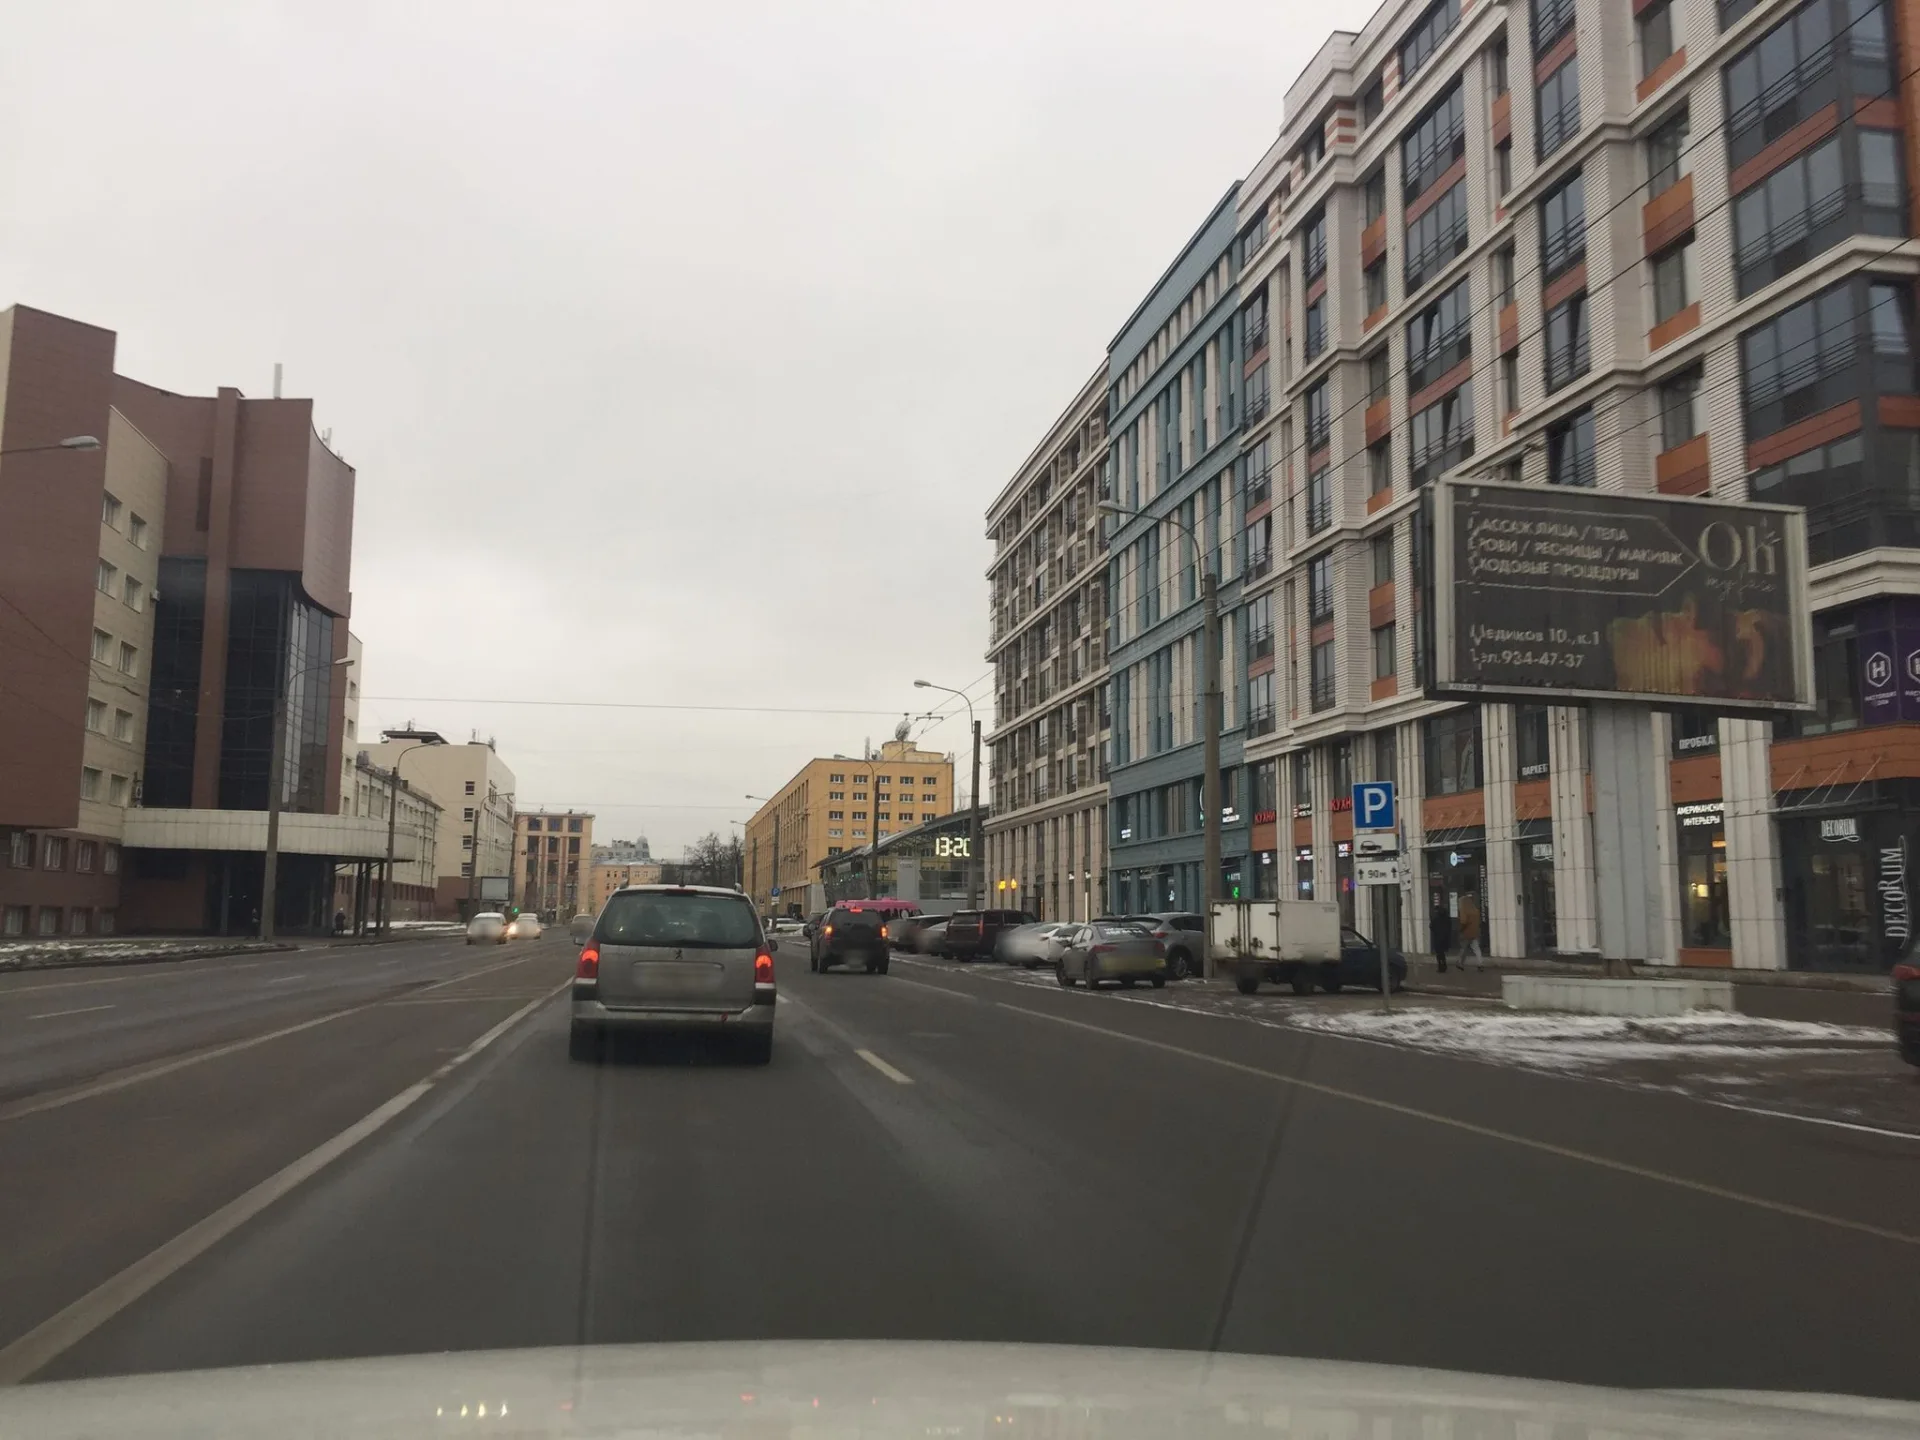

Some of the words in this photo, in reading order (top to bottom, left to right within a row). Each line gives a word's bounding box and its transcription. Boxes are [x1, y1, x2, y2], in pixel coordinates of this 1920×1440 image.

[1679, 735, 1716, 750] ПРОБКА
[1329, 796, 1353, 812] КУХН
[1676, 802, 1725, 815] АМЕРИКАНСКИЕ
[1254, 810, 1276, 823] КУХНИ
[1683, 815, 1721, 826] ИНТЕРЬЕРЫ
[1821, 818, 1857, 836] DECORUM
[1878, 847, 1908, 938] DECORUM
